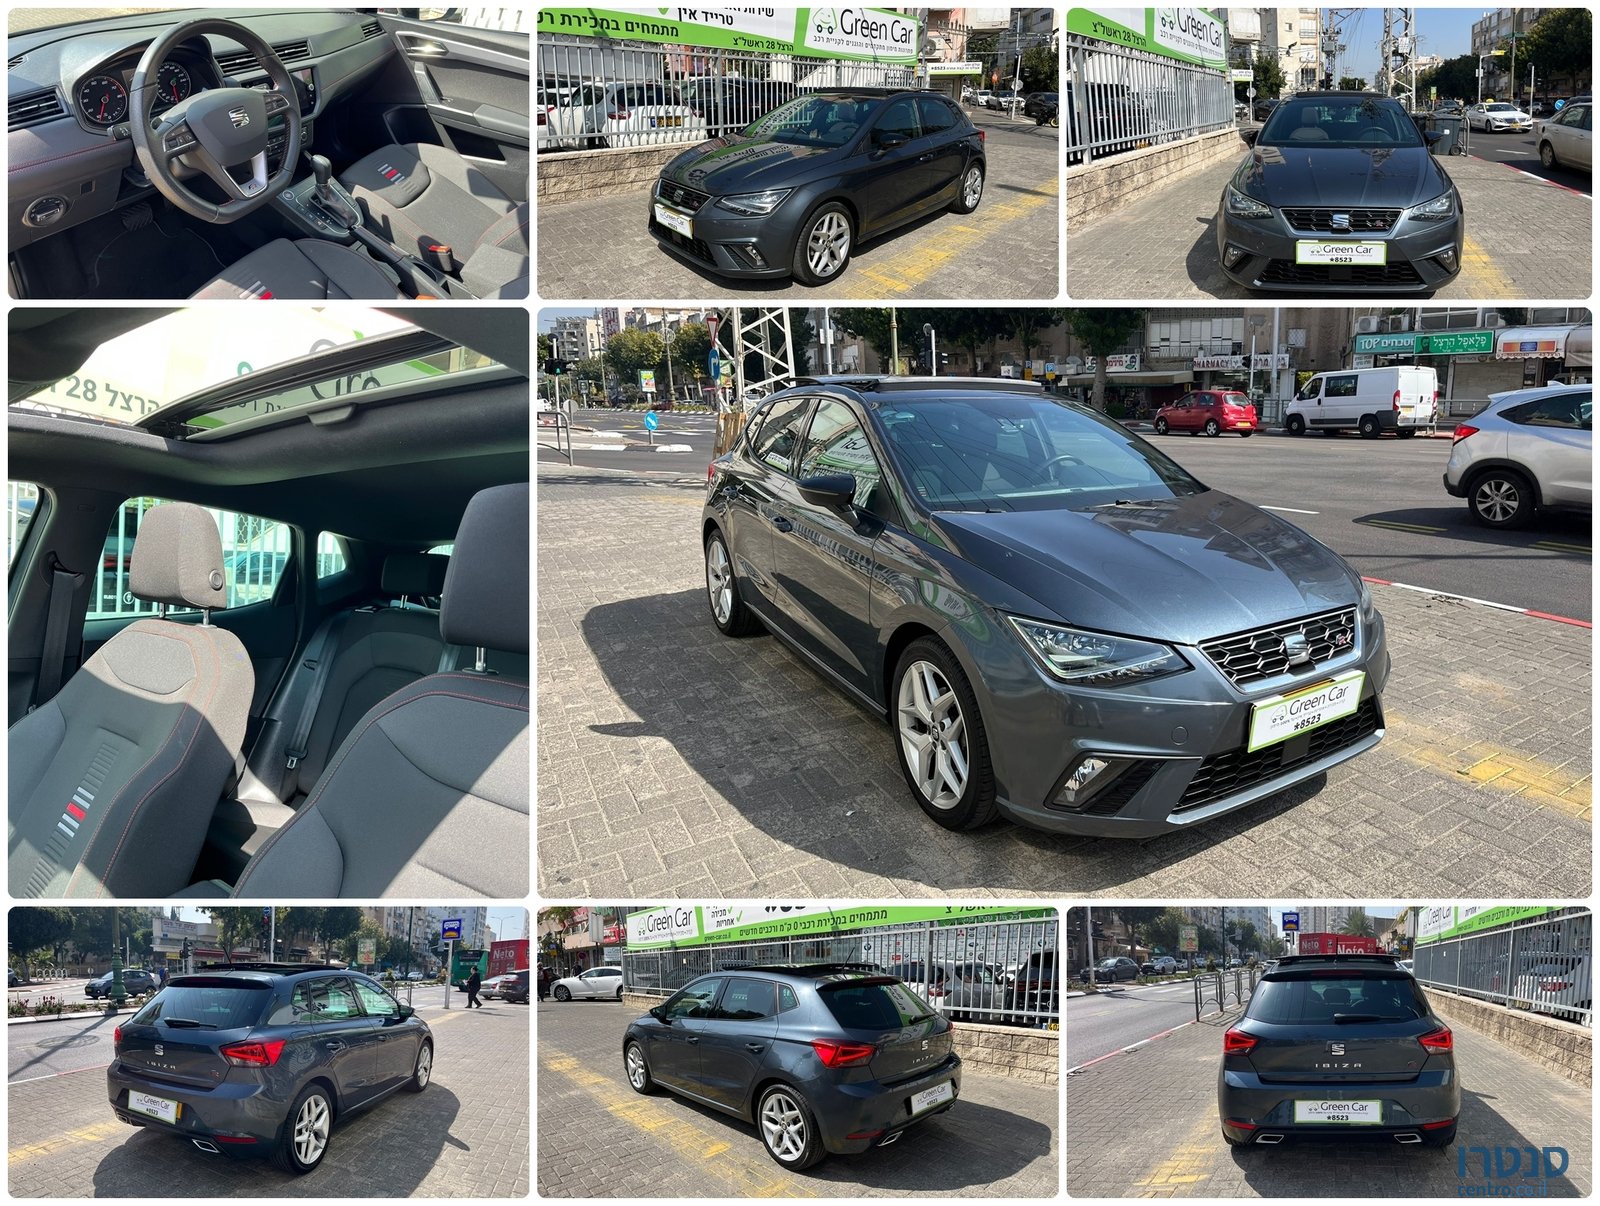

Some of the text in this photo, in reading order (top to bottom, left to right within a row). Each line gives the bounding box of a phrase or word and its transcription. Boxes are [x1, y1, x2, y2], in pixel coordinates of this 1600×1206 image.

[560, 13, 620, 31] במכירת
[678, 8, 734, 26] טרייד אין
[625, 20, 679, 37] מתמחים
[840, 9, 913, 44] Green Car
[1177, 8, 1222, 49] Green Car
[1123, 29, 1132, 42] 28
[1132, 34, 1147, 47] הרצל
[766, 41, 776, 50] 28
[777, 41, 794, 52] הרצל
[1322, 244, 1373, 254] Green Car
[1360, 338, 1380, 349] TOP
[1193, 359, 1230, 369] PHARMACY
[65, 375, 160, 415] הרצל 28
[1290, 686, 1349, 716] Green Car
[646, 907, 693, 933] Green Car
[711, 908, 727, 919] מכירה
[849, 909, 888, 923] מתמחים
[716, 917, 735, 928] אחריות
[800, 919, 815, 930] רכבי
[816, 915, 847, 928] במכירת
[739, 927, 758, 937] חדשים
[758, 923, 778, 935] ורכבים
[493, 949, 515, 960] Neto
[922, 1085, 946, 1099] Green Car
[143, 1095, 171, 1110] Green Car
[1320, 1101, 1369, 1111] Green Car
